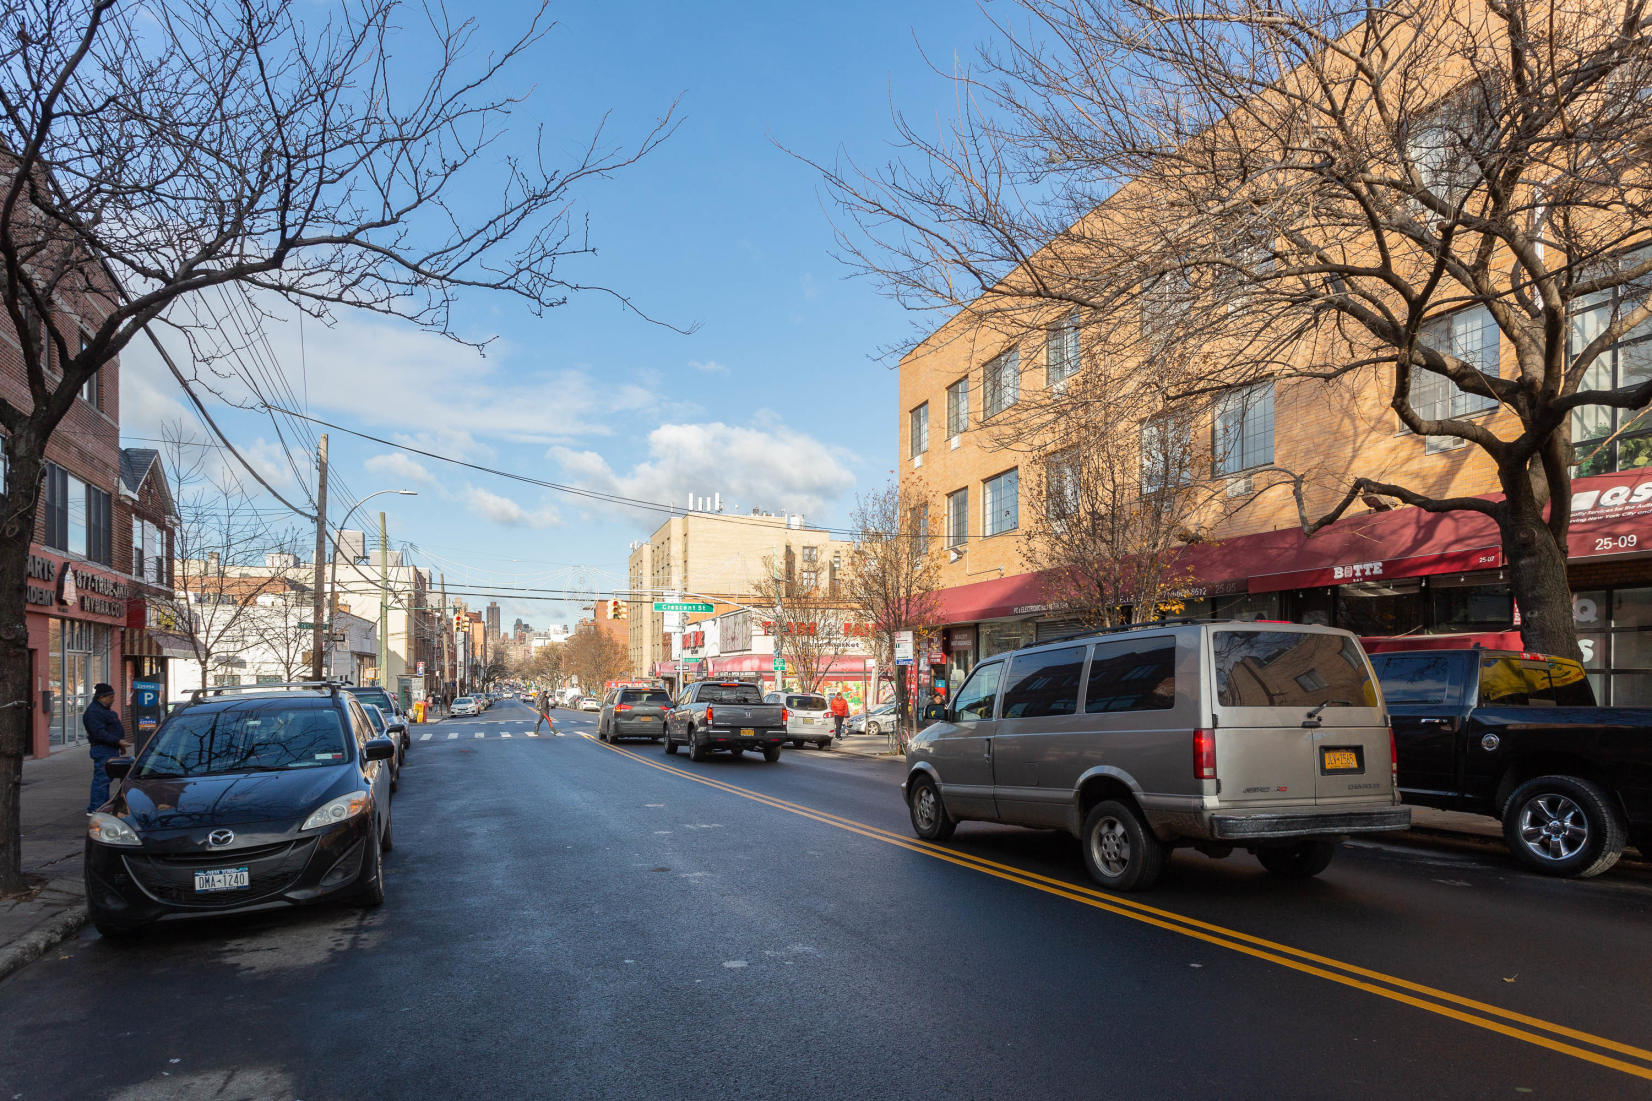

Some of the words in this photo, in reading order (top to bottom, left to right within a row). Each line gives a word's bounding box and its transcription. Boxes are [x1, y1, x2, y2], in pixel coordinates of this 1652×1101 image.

[1595, 535, 1637, 551] 25-09
[27, 554, 57, 582] ARTS
[26, 585, 56, 607] ADEMY
[144, 692, 154, 705] P
